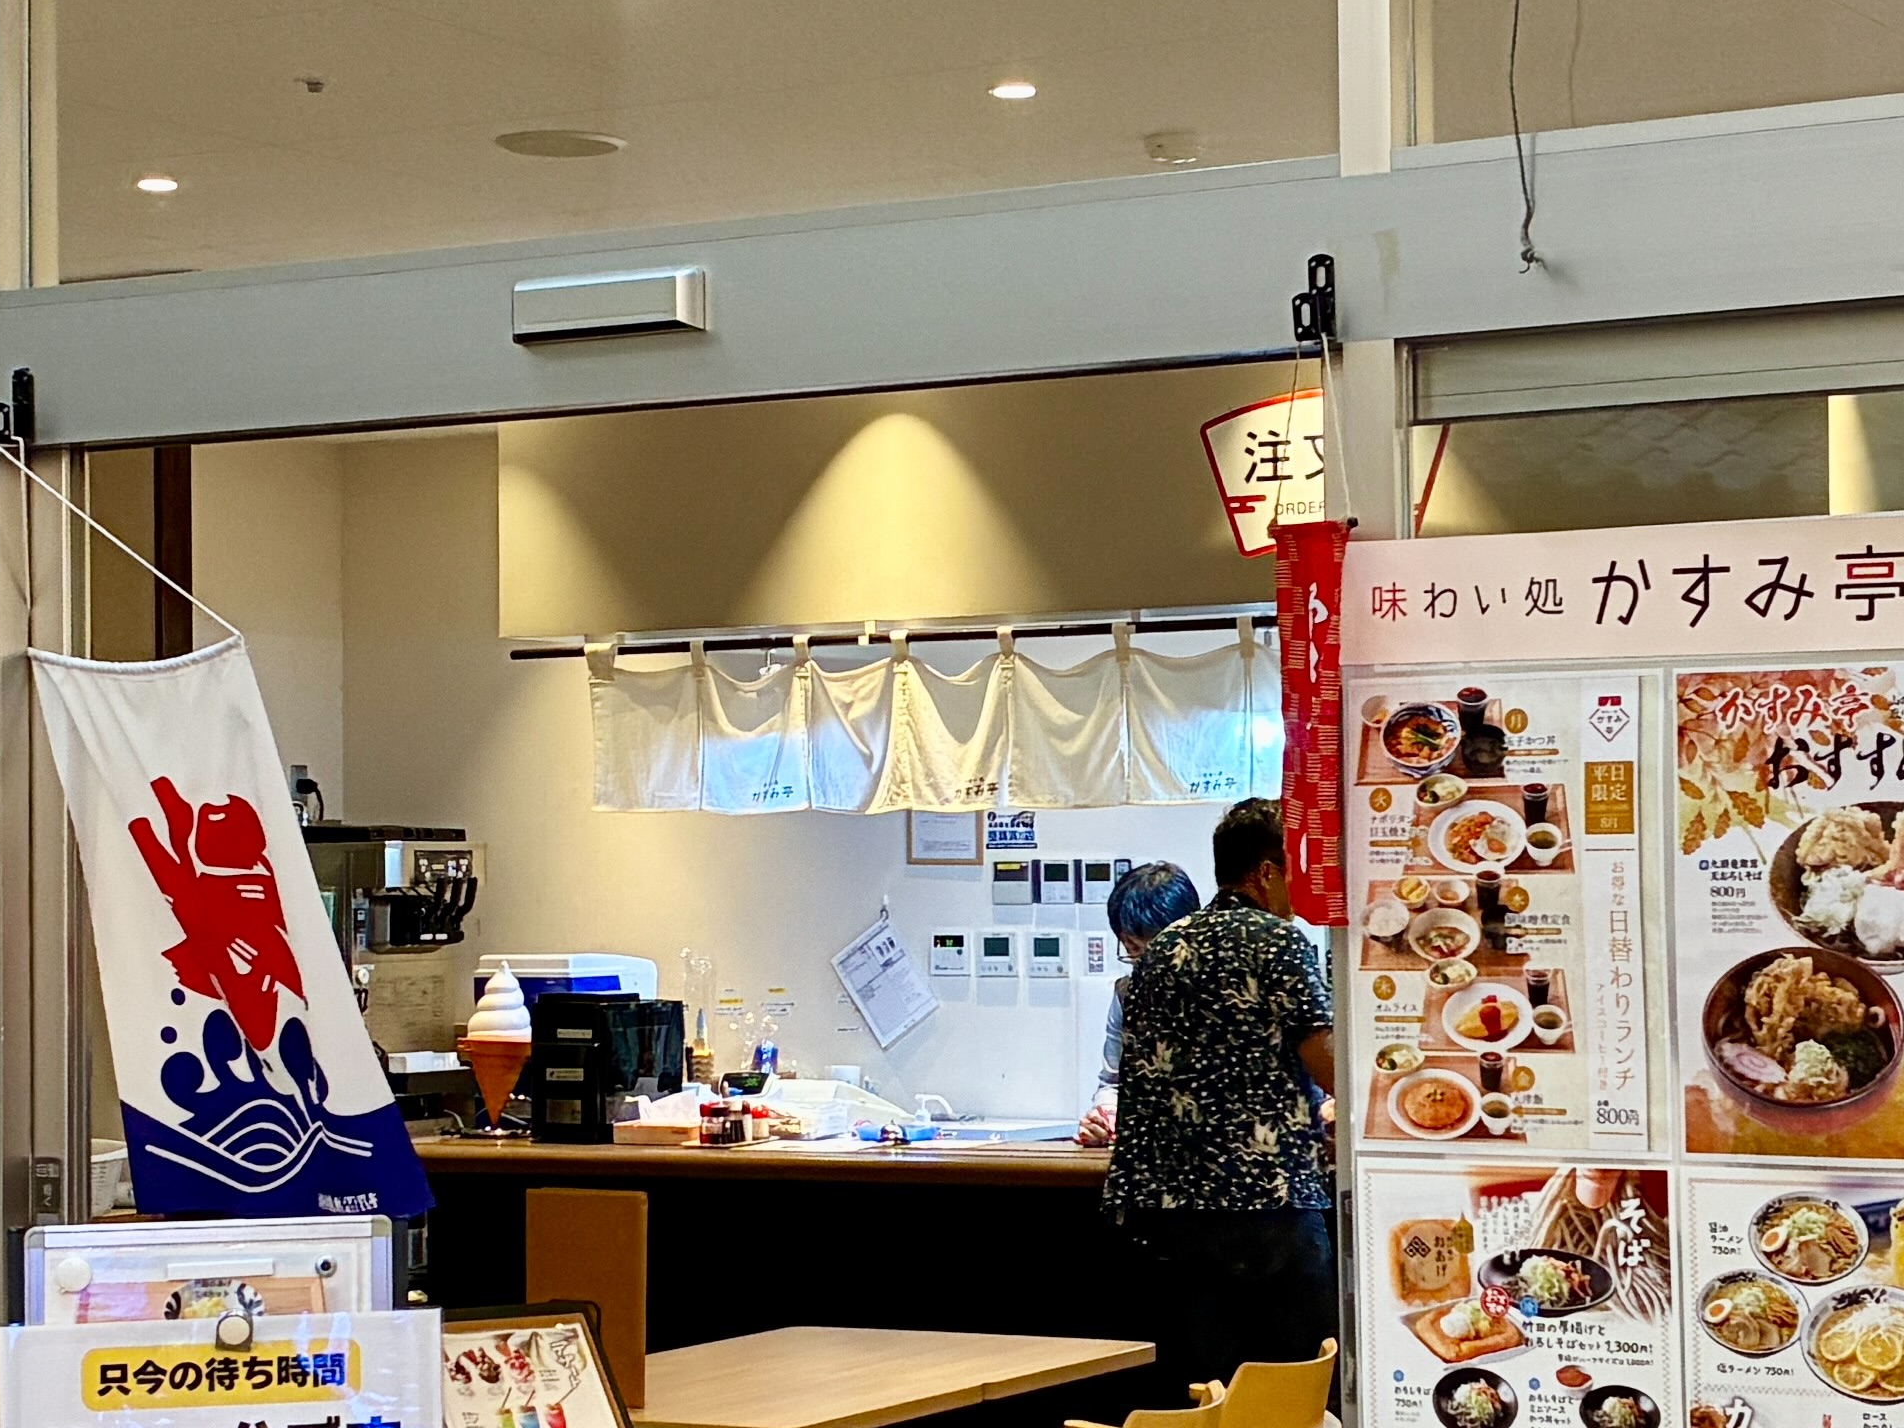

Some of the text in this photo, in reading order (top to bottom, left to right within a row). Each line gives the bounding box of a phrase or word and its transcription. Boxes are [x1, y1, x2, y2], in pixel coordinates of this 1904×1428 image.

[1371, 576, 1564, 622] 味わい処
[1716, 684, 1870, 733] かすみ亭
[1591, 764, 1625, 782] 平日
[1590, 783, 1627, 802] 限定
[1710, 885, 1748, 900] 800円
[1596, 1106, 1640, 1127] 800円
[1616, 1197, 1651, 1269] そば
[96, 1351, 347, 1398] 只今の待ち時間
